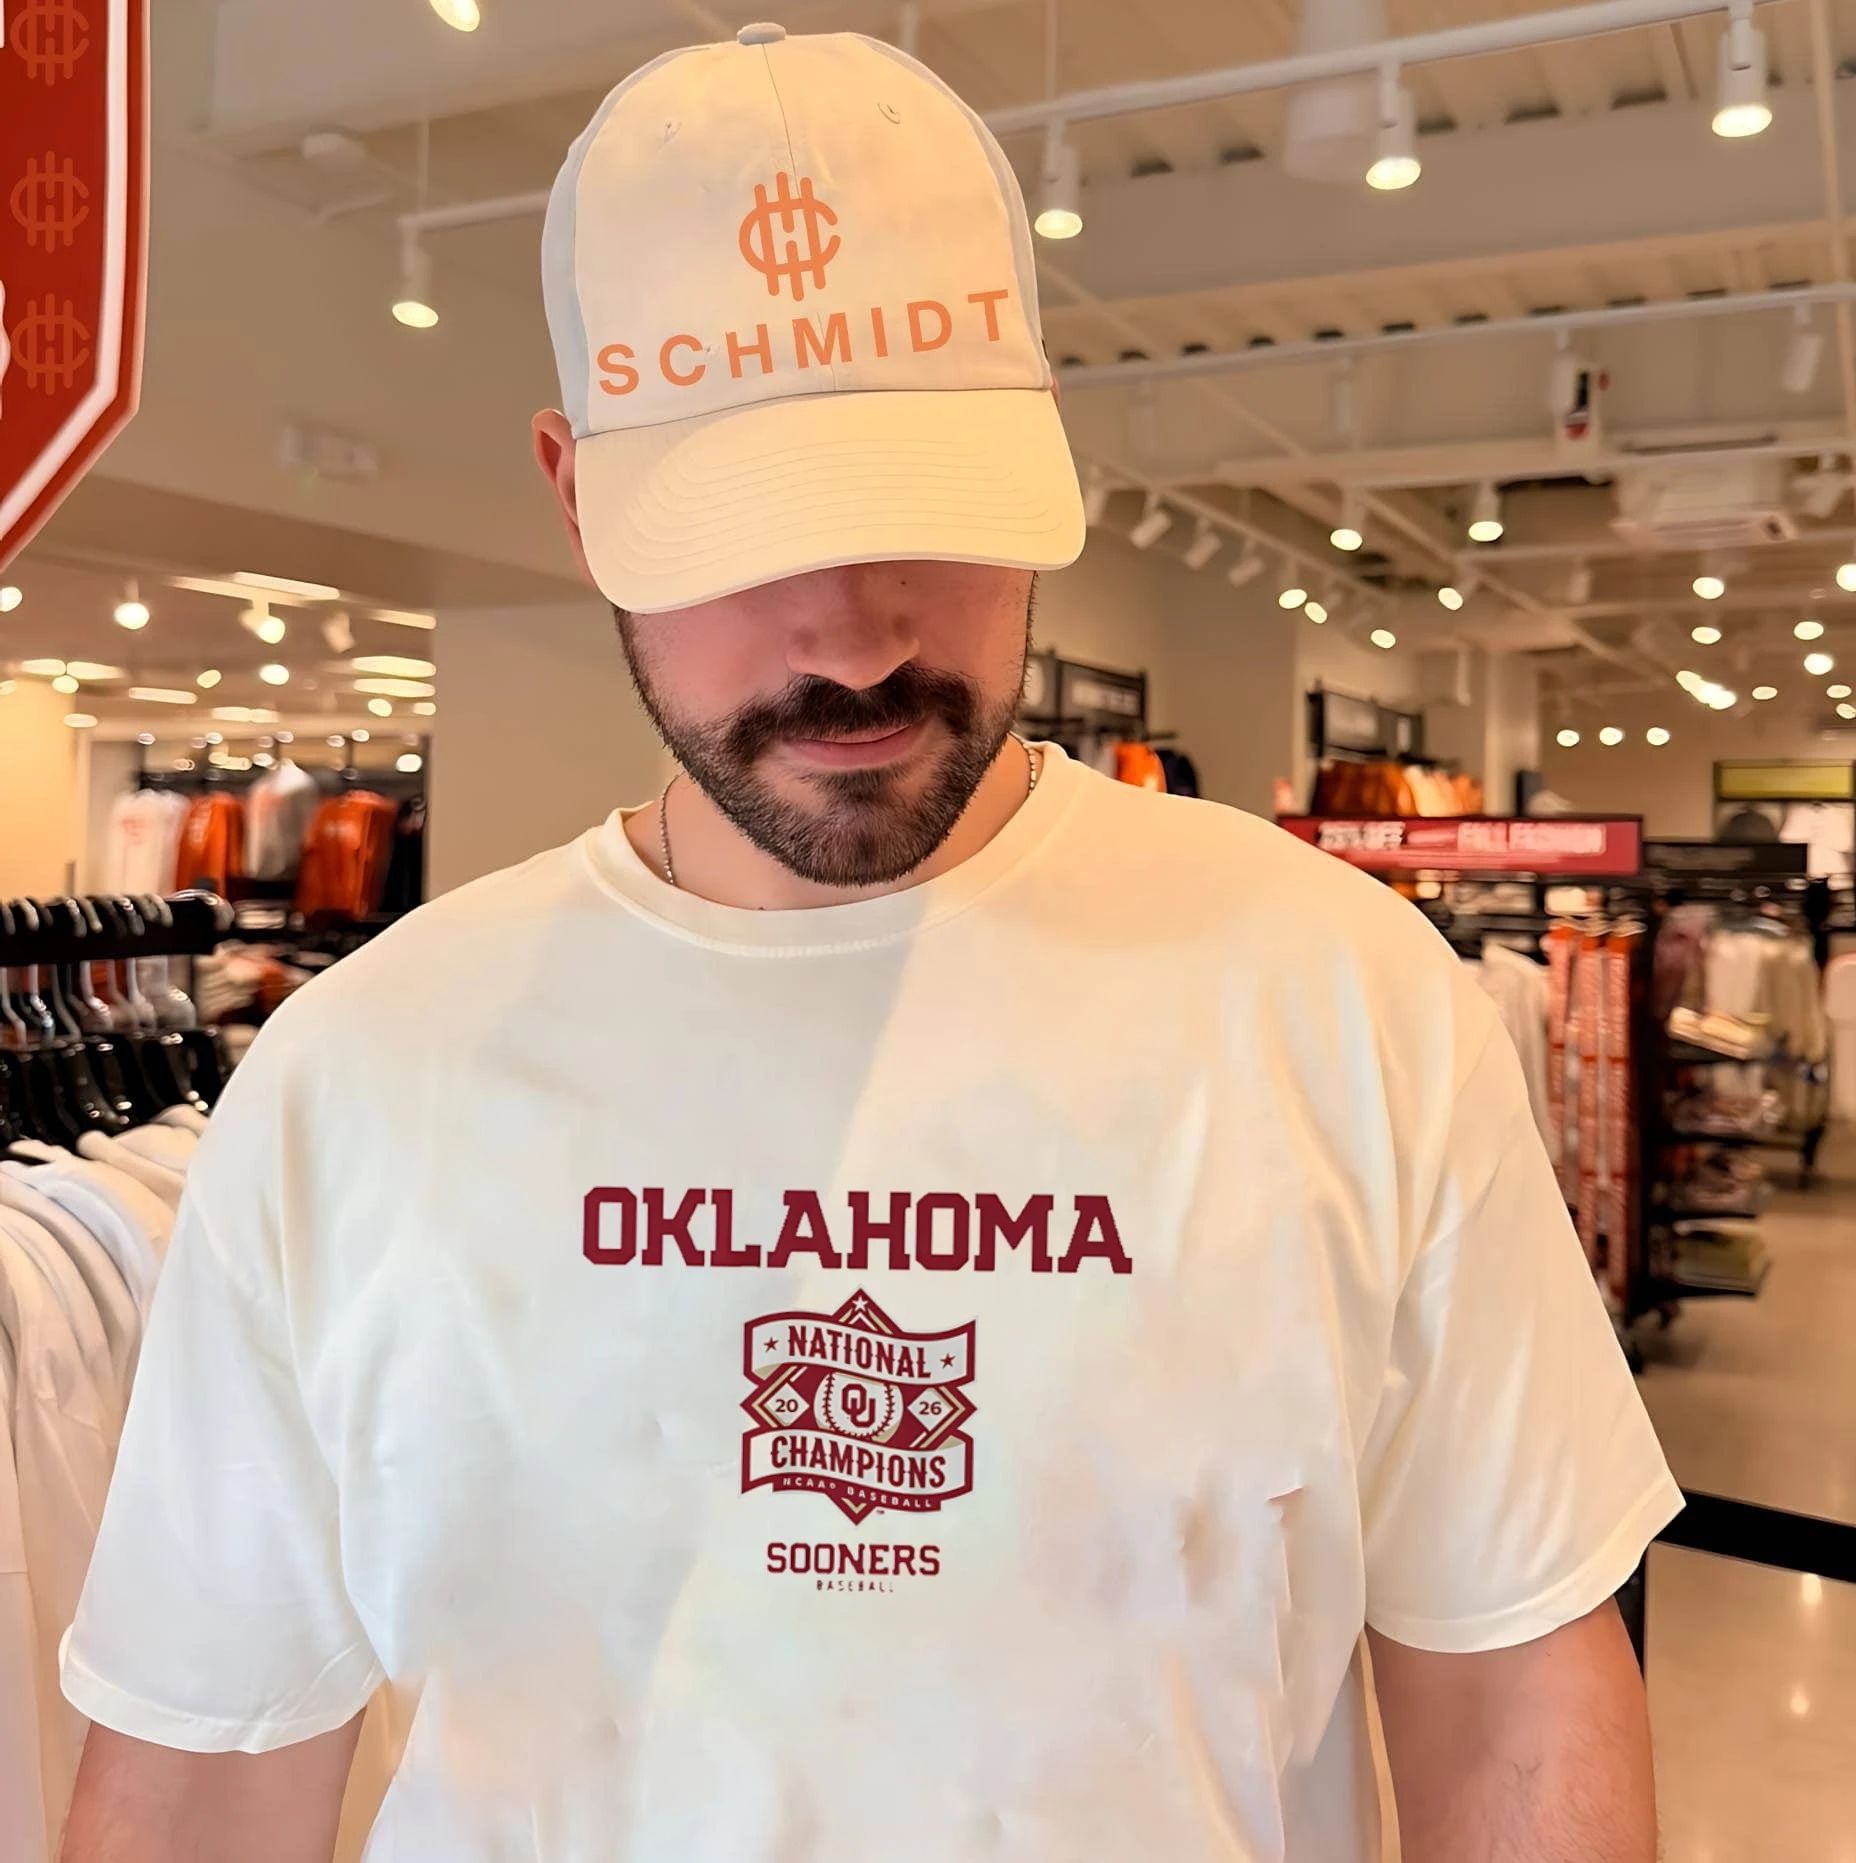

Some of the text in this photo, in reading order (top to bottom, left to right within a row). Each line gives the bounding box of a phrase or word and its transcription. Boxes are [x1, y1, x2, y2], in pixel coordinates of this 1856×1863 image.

[596, 288, 1009, 396] SCHMIDT
[583, 1186, 1133, 1274] OKLAHOMA
[788, 1325, 931, 1379] NATIONAL
[774, 1399, 798, 1412] 20
[841, 1383, 876, 1428] OU
[919, 1401, 942, 1415] 26
[770, 1436, 946, 1489] CHAMPIONS
[847, 1485, 932, 1507] BASEBALL
[767, 1542, 941, 1576] SOONERS
